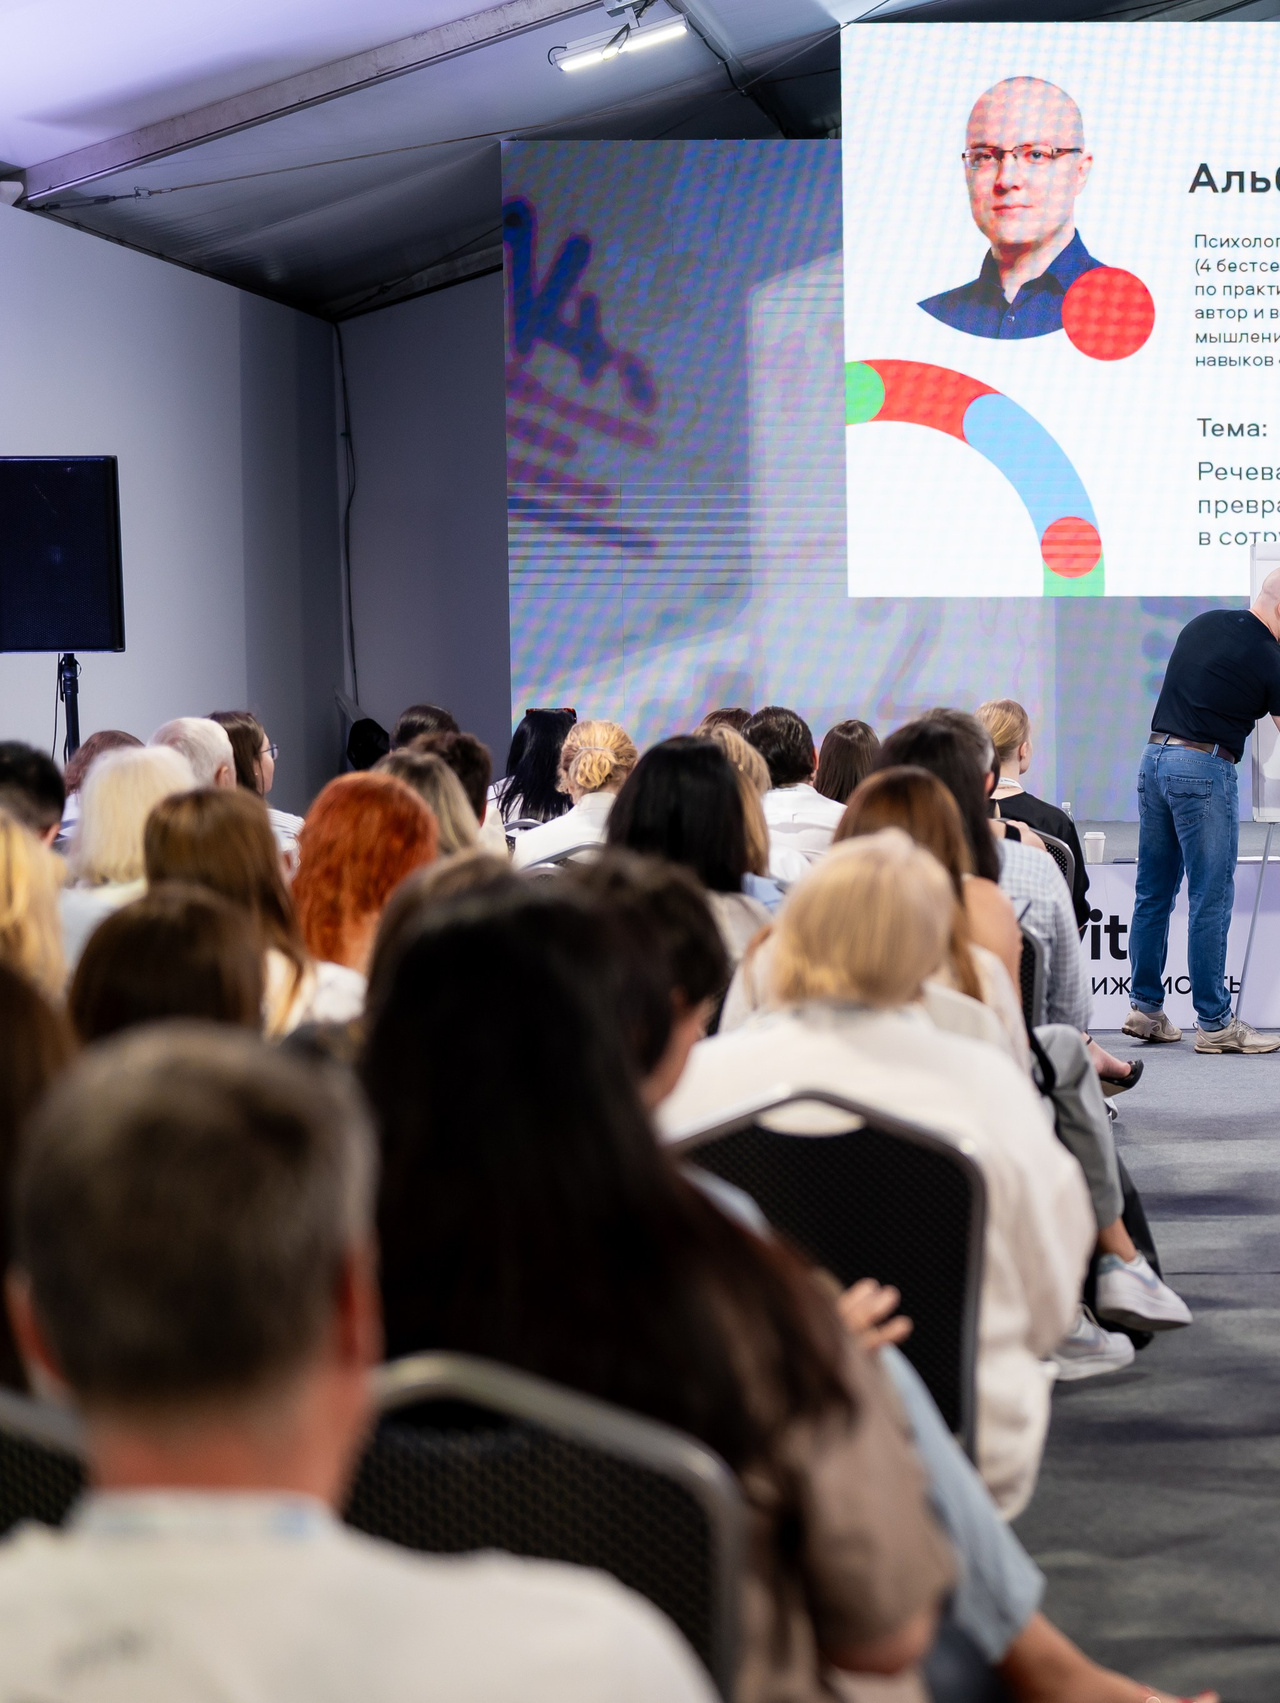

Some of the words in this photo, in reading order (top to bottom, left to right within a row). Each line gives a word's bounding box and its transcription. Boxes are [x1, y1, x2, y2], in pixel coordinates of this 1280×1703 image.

[1195, 258, 1212, 276] (4
[1195, 285, 1217, 296] по
[1194, 308, 1248, 322] автор
[1253, 308, 1264, 319] и
[1195, 355, 1274, 367] навыков
[1196, 417, 1267, 438] Тема:
[1198, 531, 1211, 546] в
